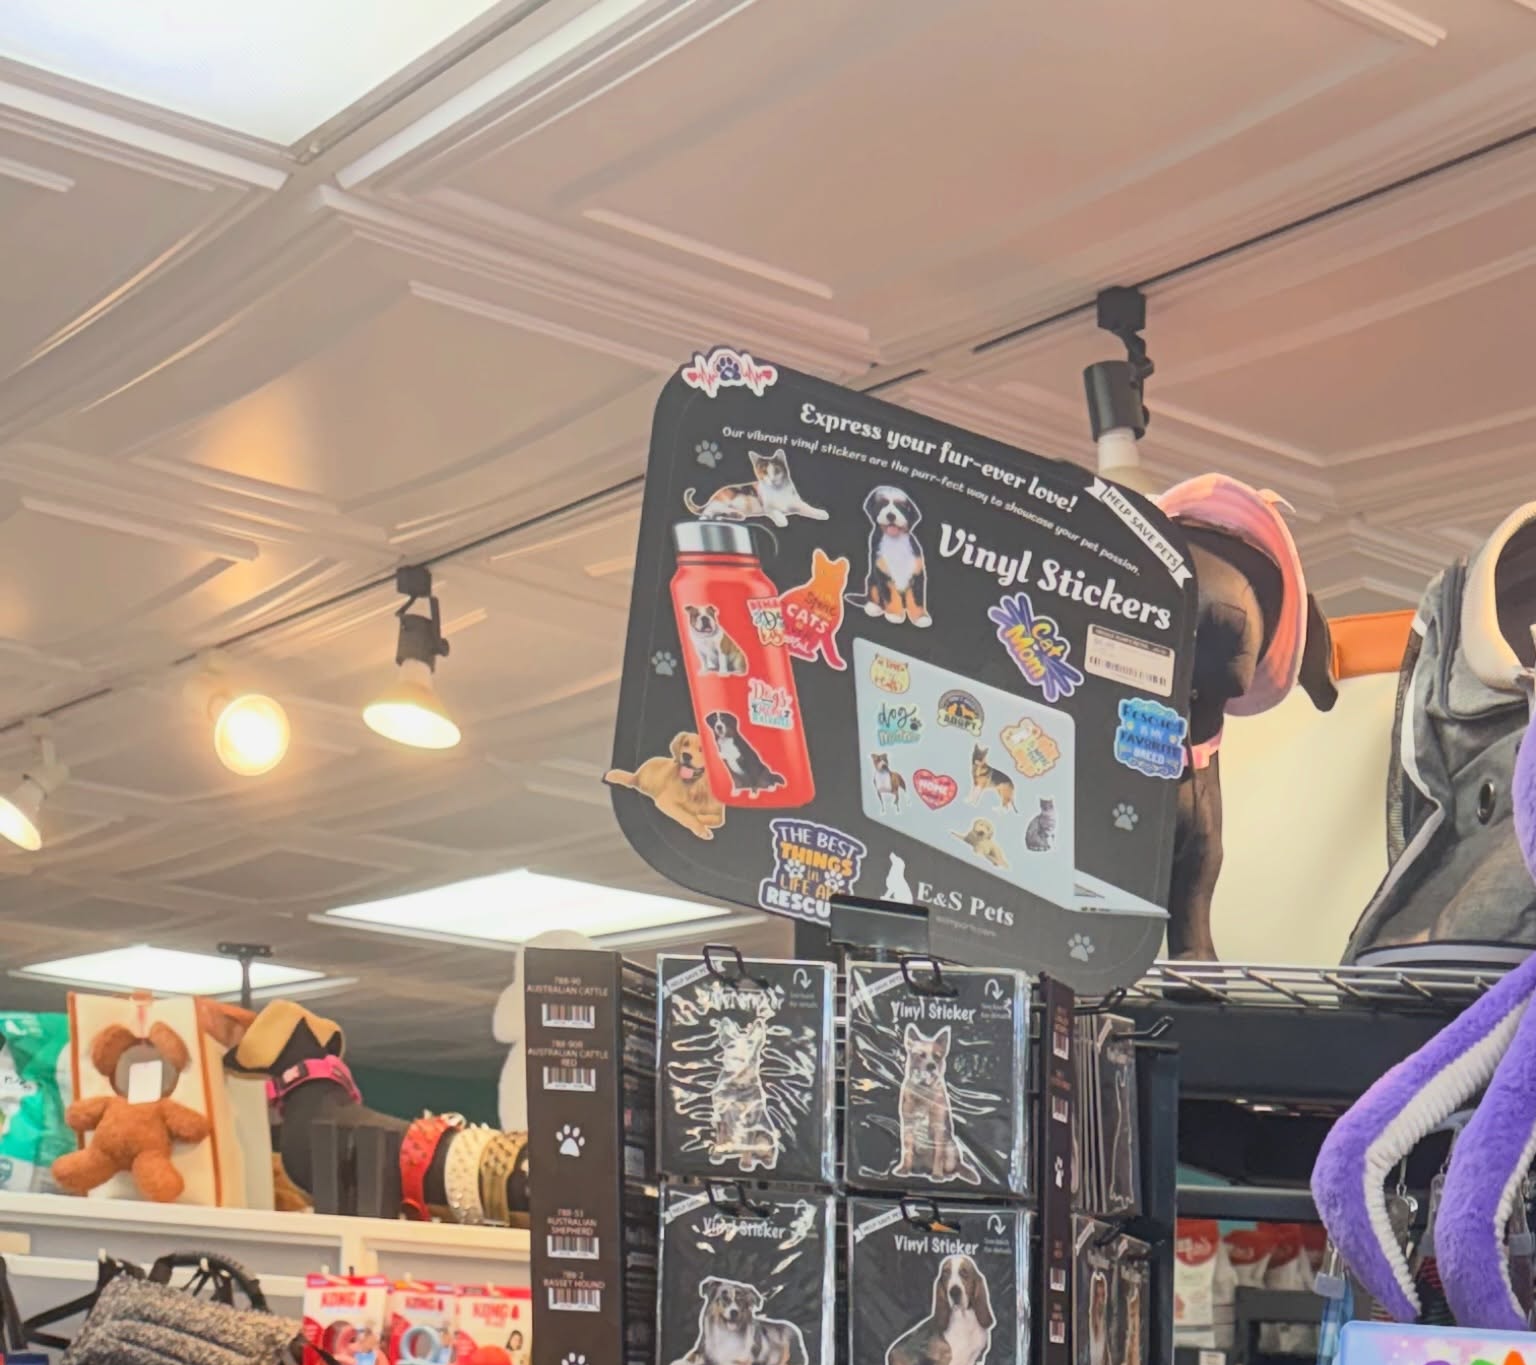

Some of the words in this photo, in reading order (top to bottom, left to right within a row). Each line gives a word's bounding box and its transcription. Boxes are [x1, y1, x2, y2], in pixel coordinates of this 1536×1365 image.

[800, 402, 882, 441] Express
[886, 429, 937, 457] your
[939, 441, 1026, 489] fur-ever
[1027, 475, 1078, 513] love!
[722, 426, 744, 440] Our
[747, 429, 788, 445] vibrant
[790, 437, 819, 454] vinyl
[821, 442, 867, 463] stickers
[869, 457, 888, 468] are
[891, 459, 910, 474] the
[911, 467, 965, 494] purr-fect
[966, 487, 988, 505] way
[990, 494, 1003, 507] to
[1004, 501, 1054, 530] showcase
[1054, 525, 1080, 544] your
[1080, 537, 1099, 553] pet
[1105, 490, 1132, 518] HELP
[1130, 516, 1156, 544] SAVE
[1154, 542, 1180, 569] PETS
[938, 522, 1033, 587] Vinyl
[1037, 558, 1171, 630] Stickers
[786, 603, 829, 635] CATS
[1030, 621, 1066, 658] Cat
[877, 702, 918, 730] dog
[777, 825, 811, 844] THE
[816, 827, 861, 858] BEST
[779, 841, 854, 877] THINGS
[779, 874, 811, 897] LIFE
[917, 881, 964, 912] E&S
[970, 896, 1015, 927] Pets
[927, 1001, 977, 1022] Sticker
[895, 1235, 929, 1254] Vinyl
[931, 1238, 979, 1256] Sticker
